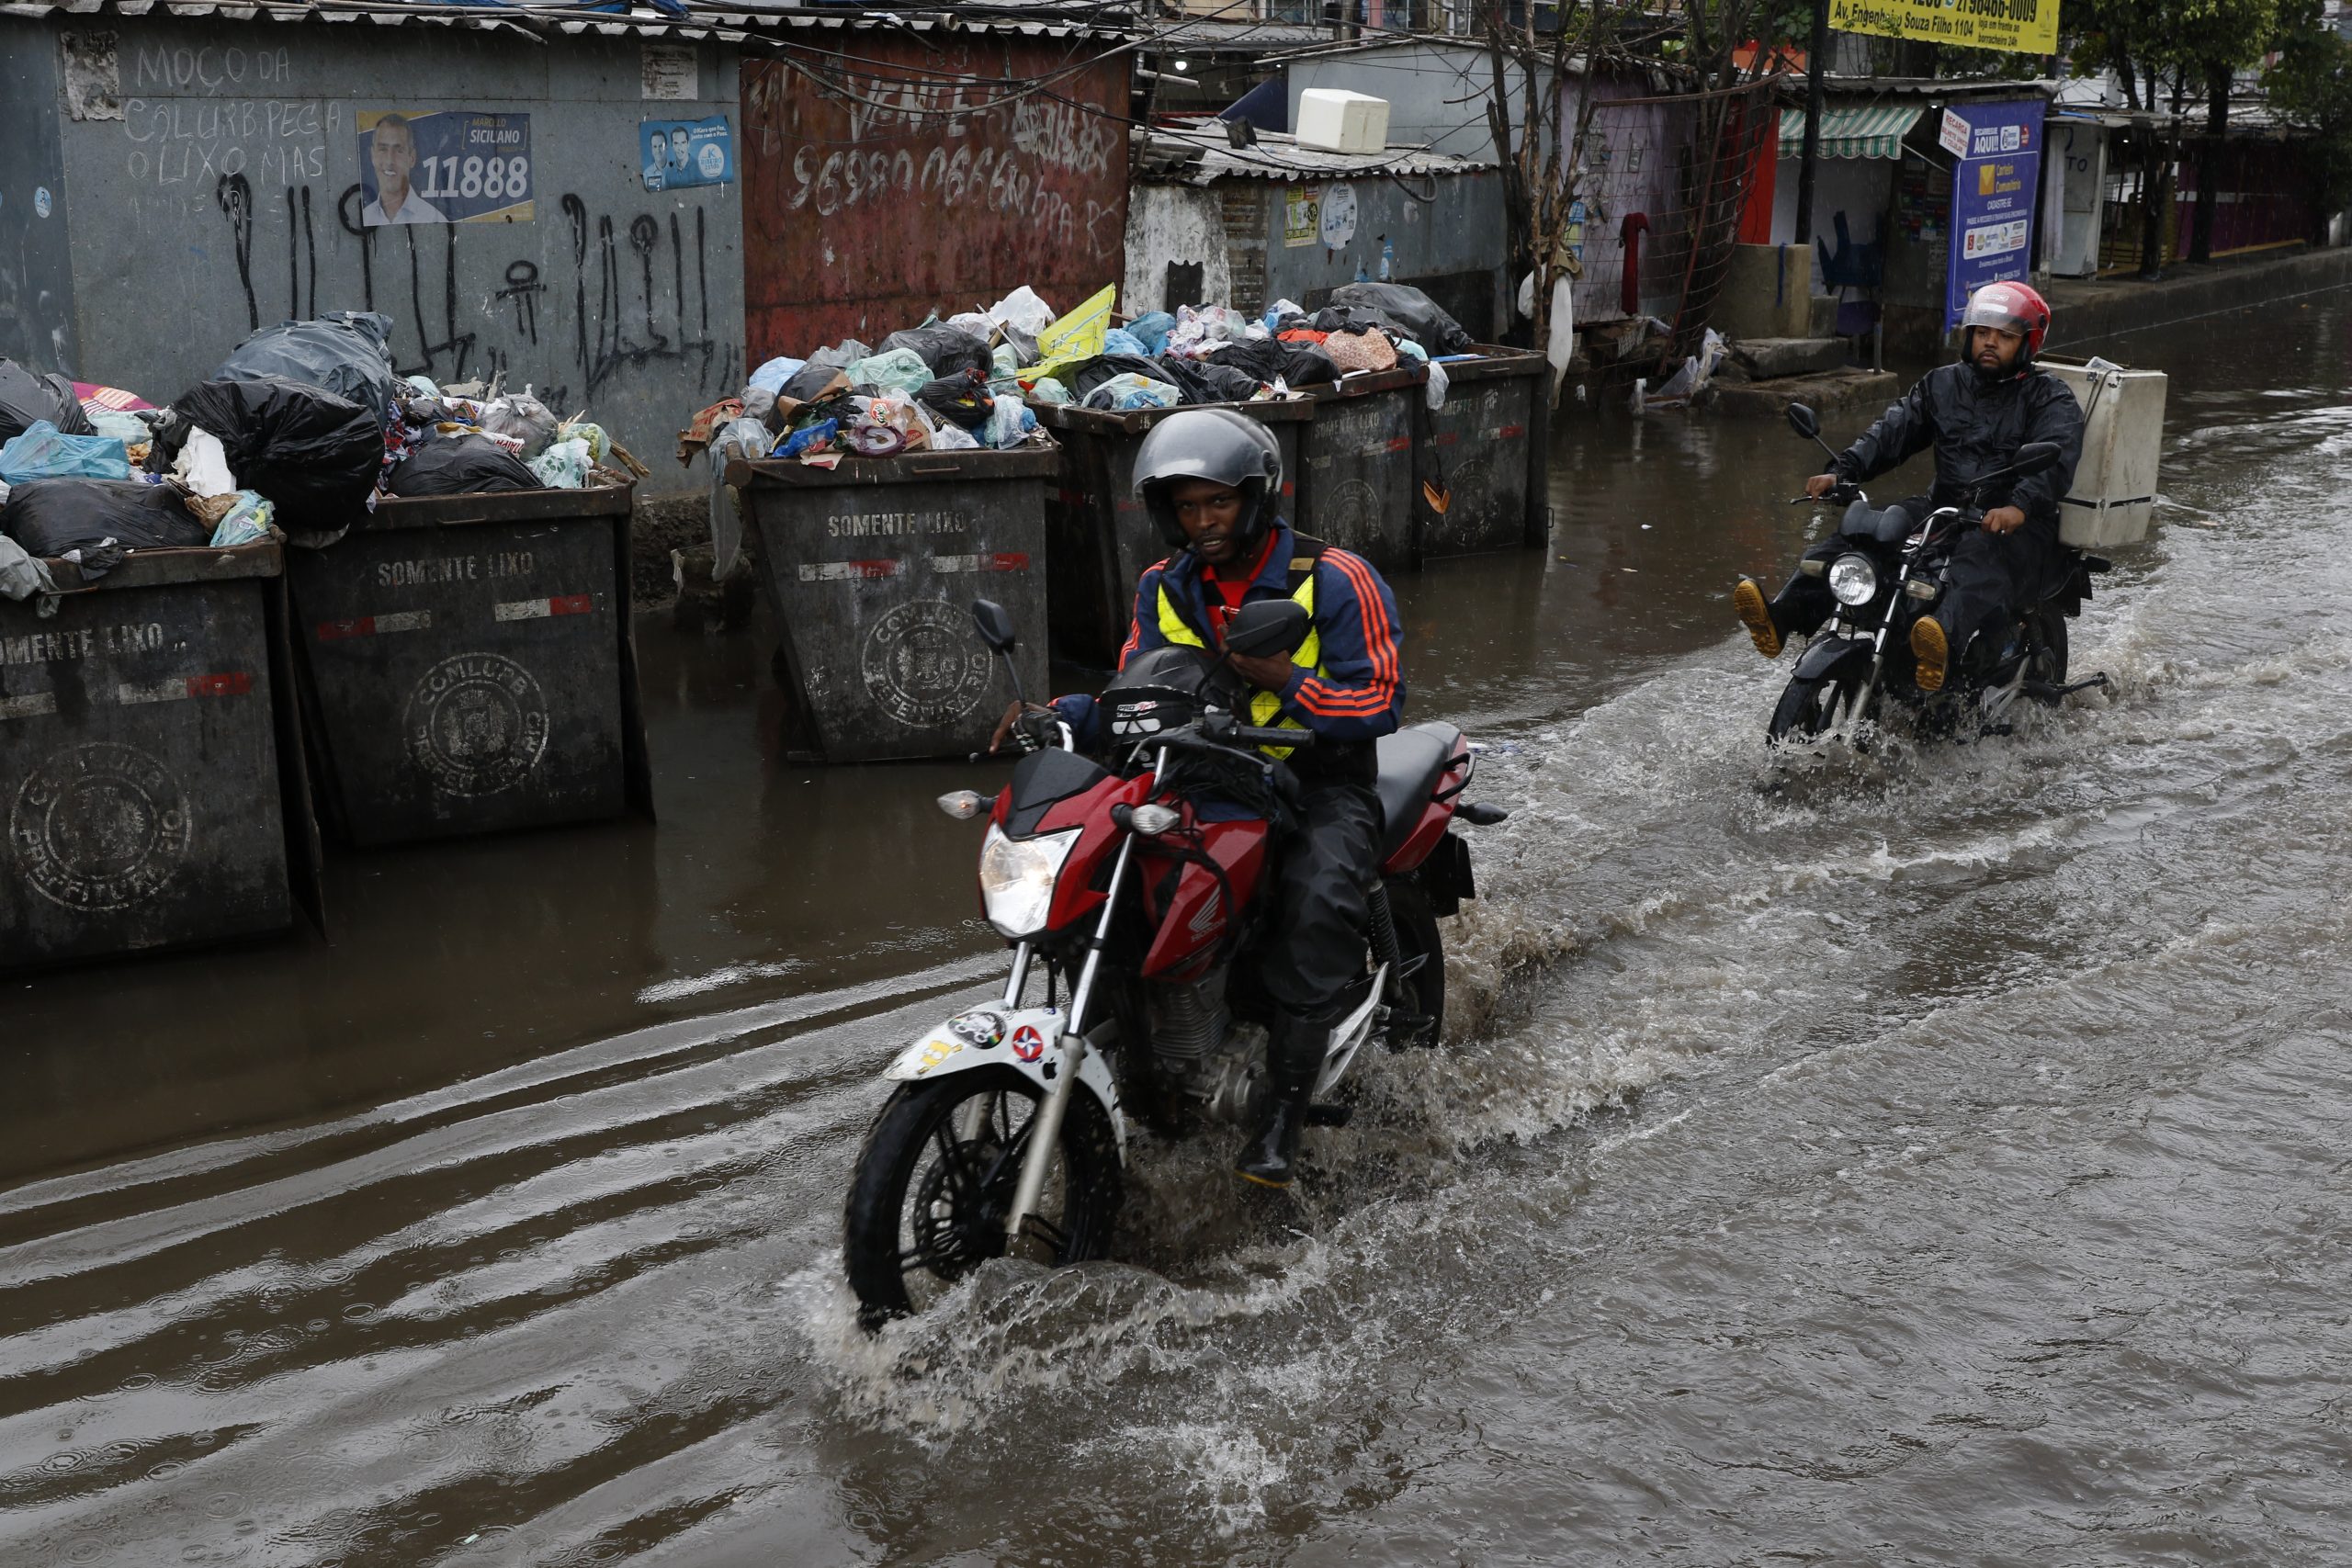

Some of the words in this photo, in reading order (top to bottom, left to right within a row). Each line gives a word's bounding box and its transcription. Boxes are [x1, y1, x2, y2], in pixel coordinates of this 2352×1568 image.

[1835, 2, 1849, 19] Av.
[1852, 4, 1902, 28] Engenho
[1905, 12, 1929, 31] Souza
[1932, 16, 1952, 35] Filho
[1954, 19, 1973, 37] 1104
[1978, 18, 1987, 30] loja
[1989, 21, 1996, 29] em
[1997, 20, 2013, 31] frente
[138, 44, 246, 96] MOÇO
[257, 47, 289, 82] DA
[266, 100, 341, 140] PEGA
[1945, 114, 1967, 135] RECARGA
[1973, 135, 1999, 153] AQUI!!
[159, 139, 247, 187] LIXO
[261, 144, 325, 185] MAS
[421, 155, 528, 198] 11888
[828, 513, 916, 537] SOMENTE
[925, 511, 967, 533] LIXO
[378, 553, 479, 587] SOMENTE
[488, 551, 535, 579] LIXO
